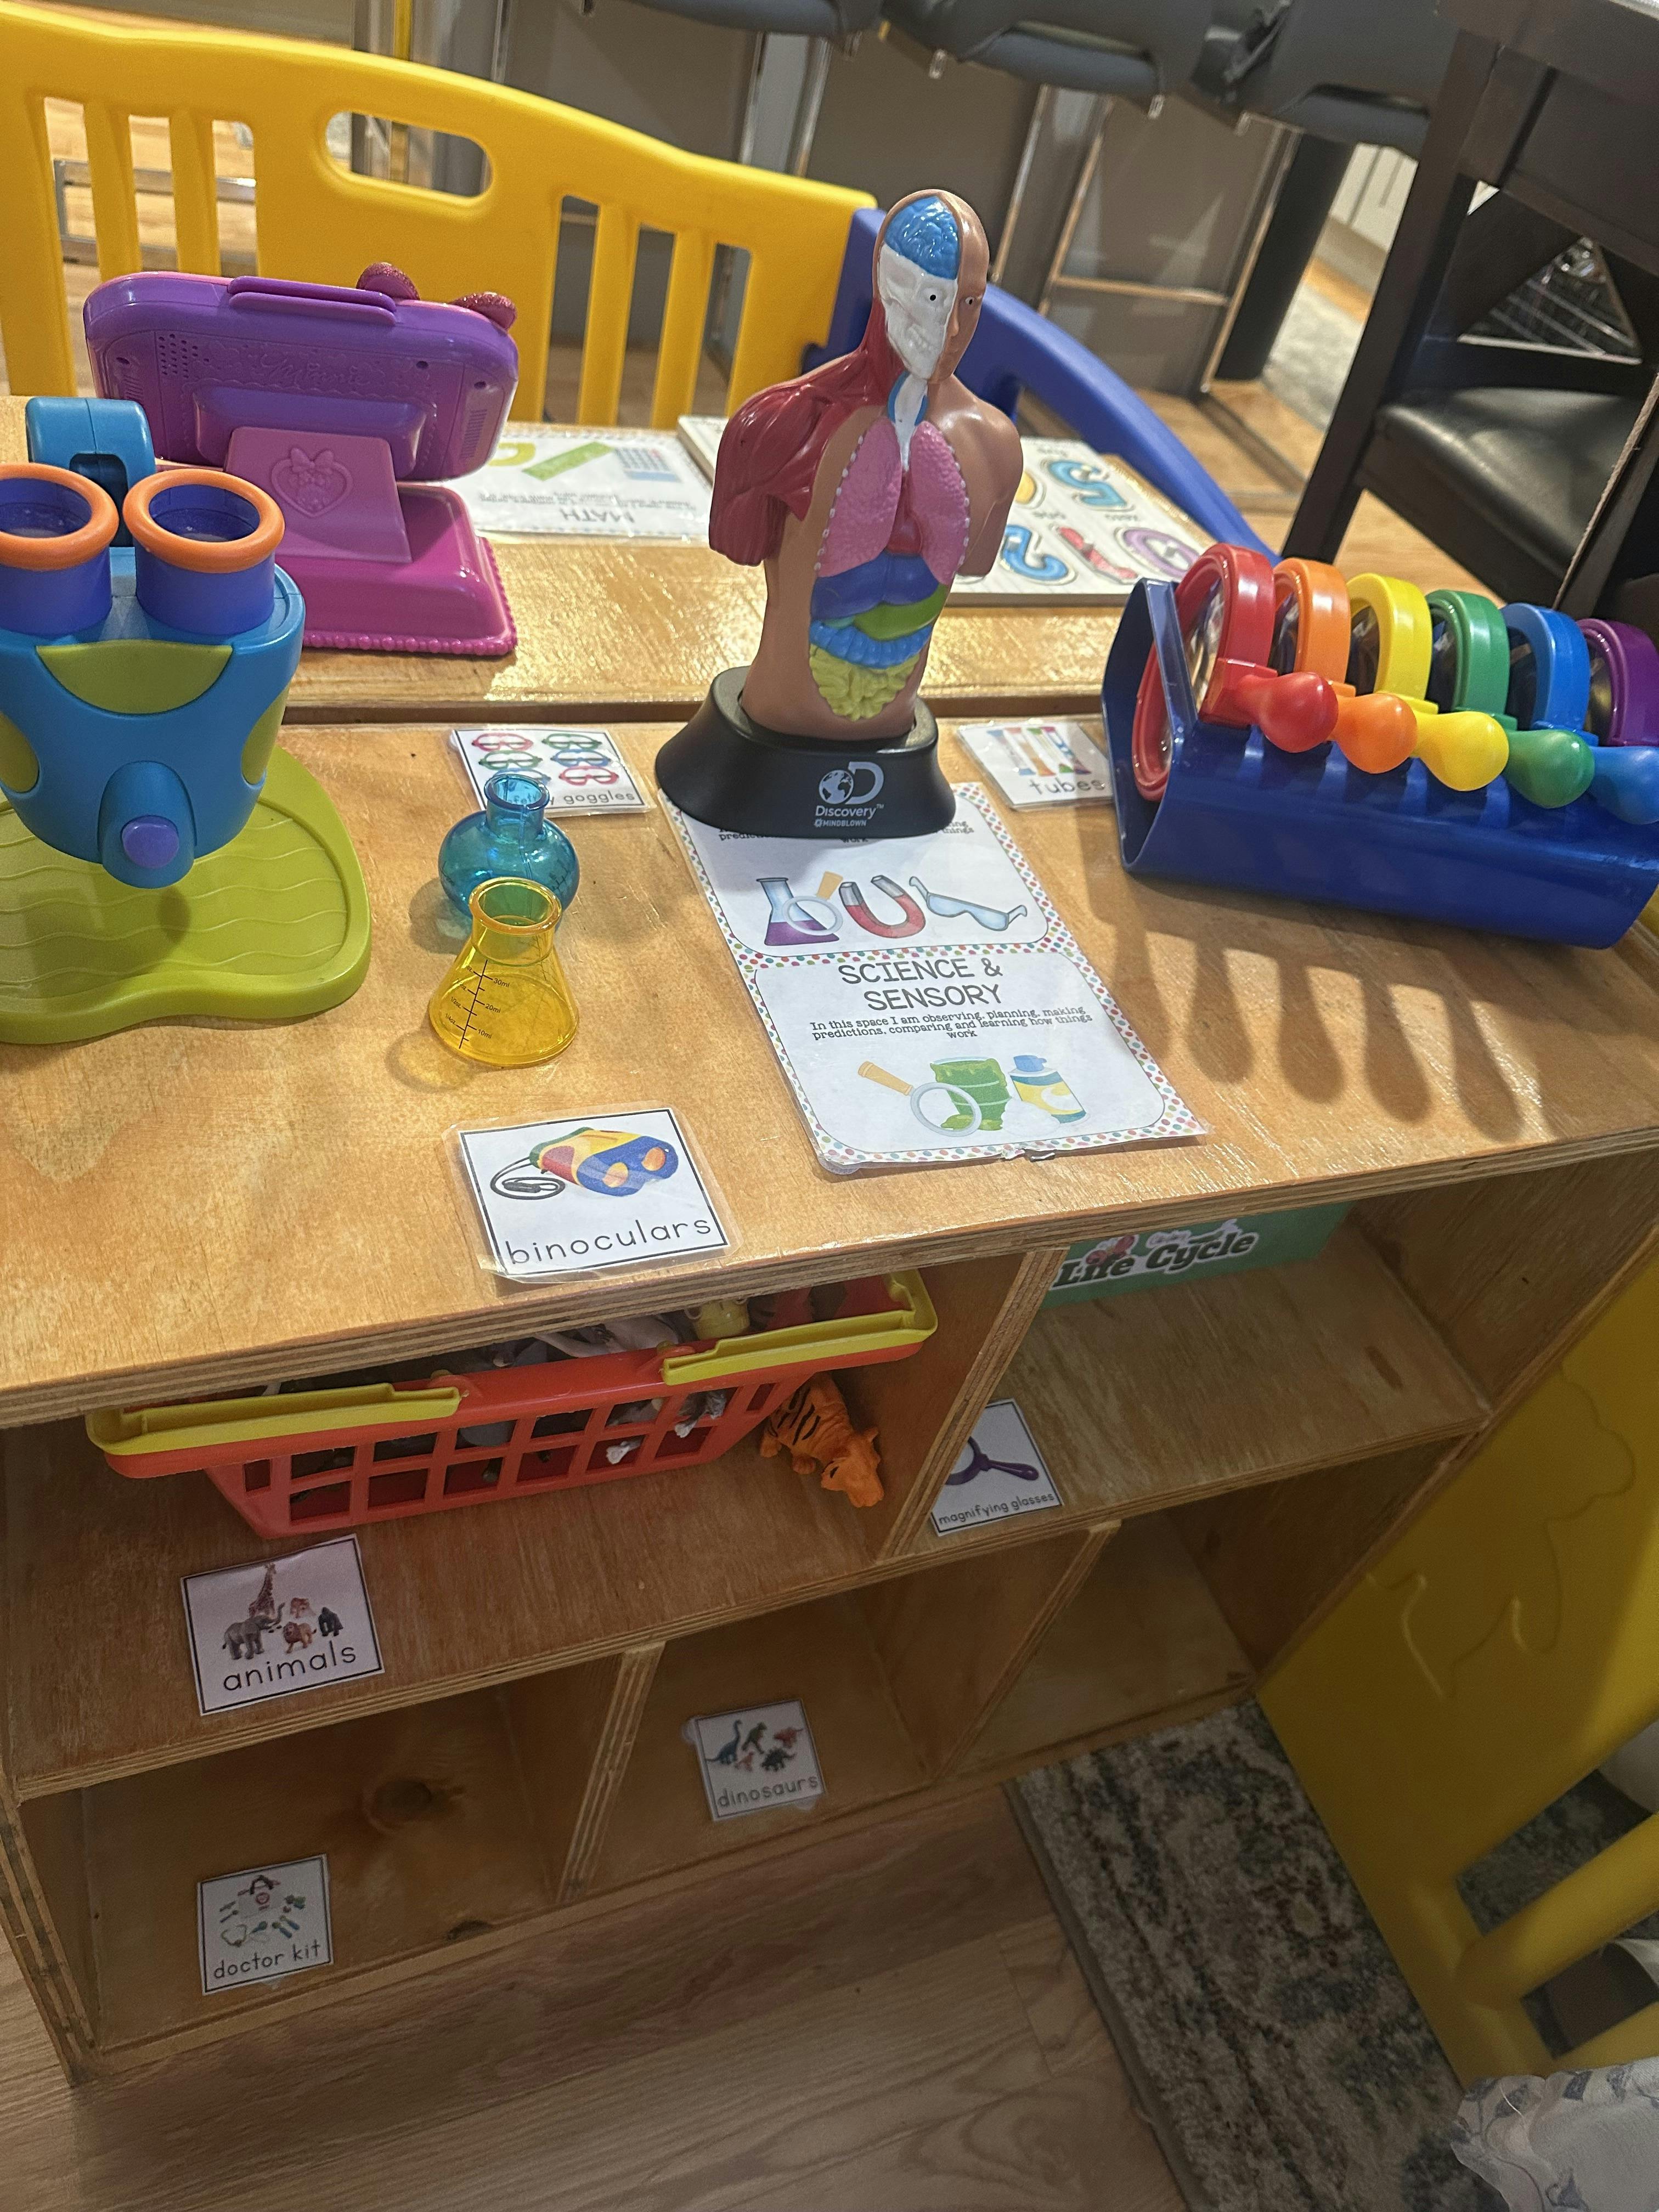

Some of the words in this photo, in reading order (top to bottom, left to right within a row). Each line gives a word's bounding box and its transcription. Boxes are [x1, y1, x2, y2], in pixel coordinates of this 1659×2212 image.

[563, 790, 635, 805] goggles
[1029, 777, 1105, 795] tubes
[493, 978, 510, 988] 30ml
[838, 958, 975, 984] SCIENCE
[983, 957, 1004, 978] &
[485, 1003, 501, 1014] 20ml
[864, 983, 1003, 1011] SENSORY
[810, 1022, 827, 1031] In
[829, 1020, 854, 1029] this
[856, 1018, 889, 1028] space
[890, 1016, 899, 1025] I
[901, 1015, 920, 1024] am
[1042, 1006, 1086, 1017] making
[889, 1023, 953, 1034] comparing
[955, 1020, 977, 1029] and
[976, 1018, 1028, 1028] learning
[1029, 1017, 1053, 1026] how
[1055, 1014, 1093, 1024] things
[477, 1029, 492, 1040] 10ml
[946, 1029, 978, 1039] work
[505, 1219, 712, 1265] binoculars
[1052, 1252, 1135, 1288] Life
[1146, 1232, 1256, 1272] Cycle
[939, 1503, 1009, 1526] magnifying
[1011, 1493, 1055, 1510] glasses
[223, 1639, 357, 1691] animals
[717, 1775, 819, 1808] dinosaurs
[213, 1952, 285, 1979] doctor
[292, 1938, 321, 1962] kit
